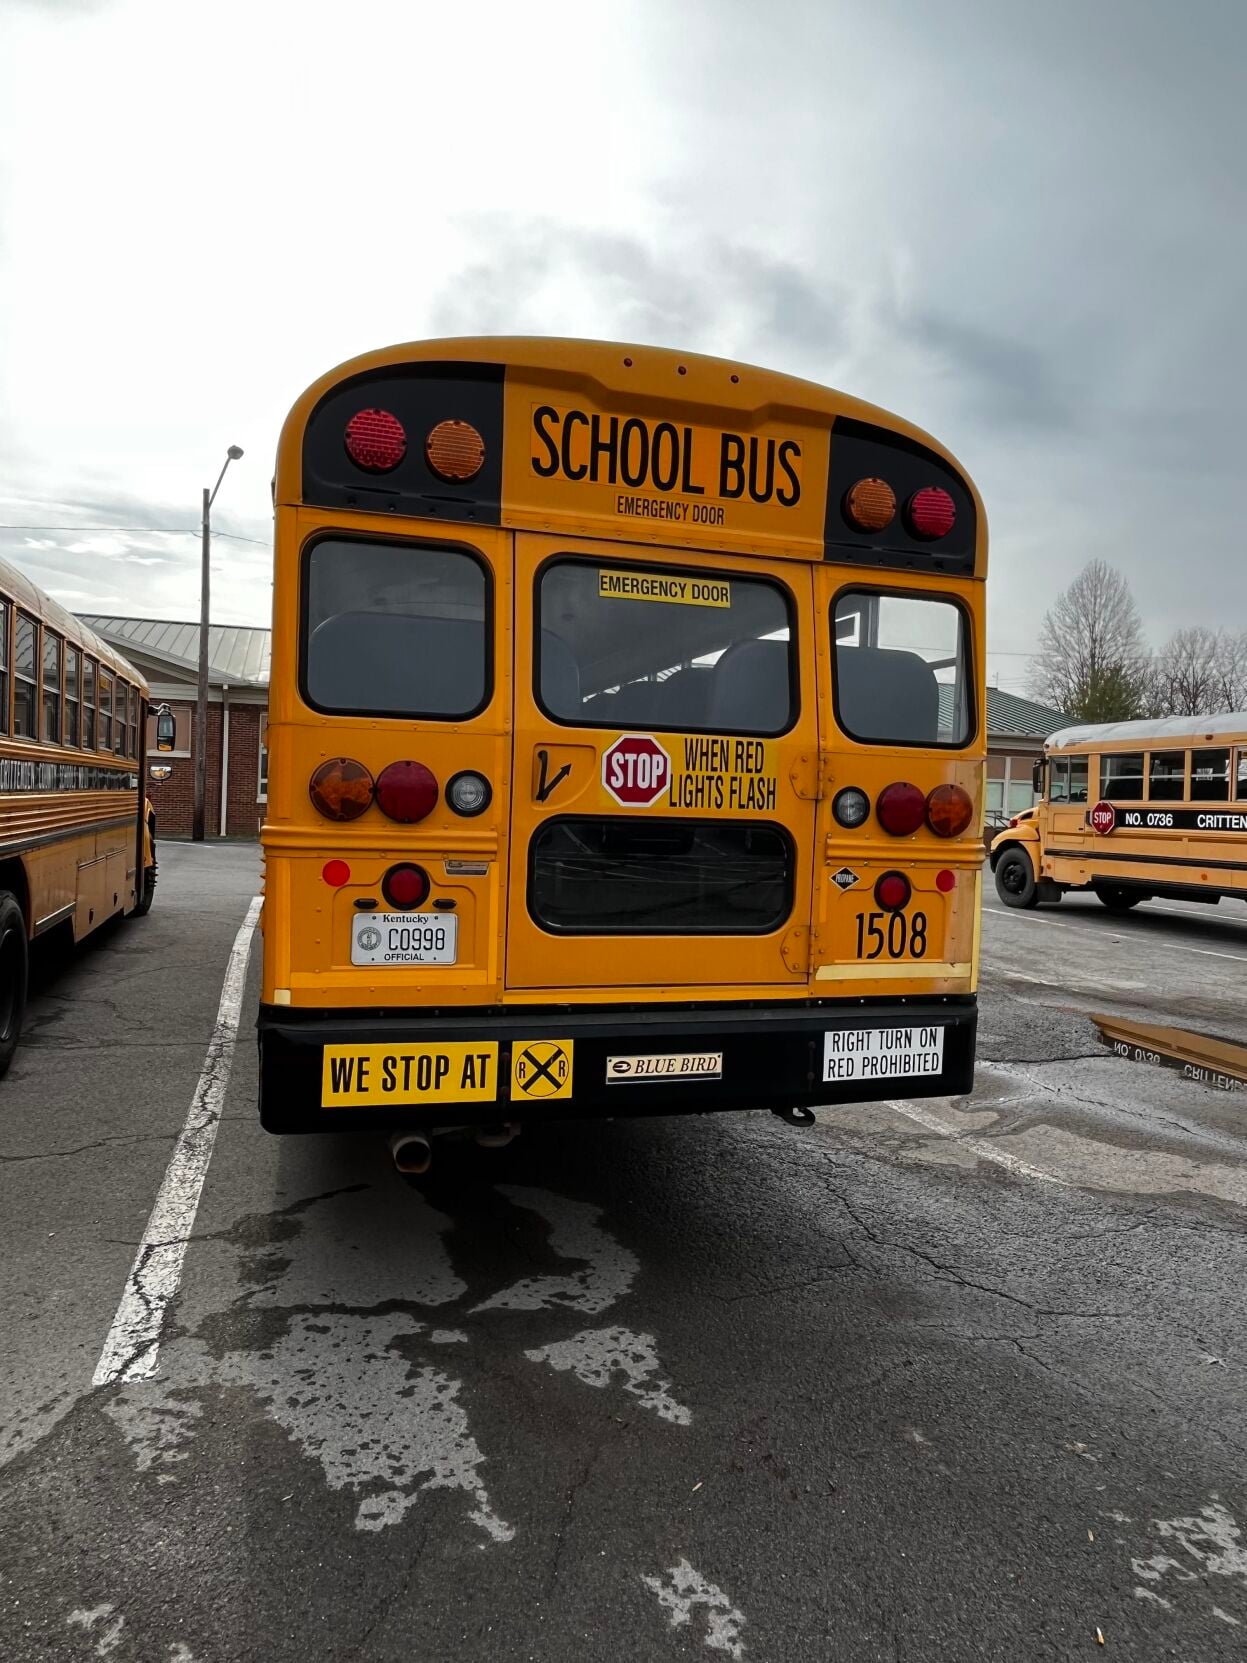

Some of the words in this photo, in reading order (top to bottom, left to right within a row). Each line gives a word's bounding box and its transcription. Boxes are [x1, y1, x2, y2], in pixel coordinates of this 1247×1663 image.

[531, 405, 705, 494] SCHOOL
[718, 432, 802, 507] BUS
[617, 496, 690, 522] EMERGENCY
[692, 504, 725, 526] DOOR
[600, 575, 687, 598] EMERGENCY
[691, 583, 729, 602] DOOR
[684, 737, 730, 773] WHEN
[734, 740, 765, 774] RED
[610, 752, 665, 789] STOP
[669, 773, 724, 809] LIGHTS
[729, 775, 777, 810] FLASH
[1093, 811, 1112, 824] STOP
[1125, 812, 1143, 826] NO.
[1146, 813, 1173, 826] 0736
[382, 914, 429, 924] Kentucky
[388, 928, 445, 951] C0998
[855, 911, 927, 960] 1508
[384, 953, 424, 961] OFFICIAL
[832, 1031, 872, 1053] RIGHT
[878, 1029, 912, 1050] TURN
[919, 1028, 937, 1048] ON
[330, 1056, 370, 1094] WE
[381, 1055, 450, 1092] STOP
[460, 1054, 491, 1089] AT
[634, 1058, 677, 1074] BLUE
[680, 1056, 718, 1073] BIRD
[828, 1057, 854, 1079] RED
[862, 1052, 939, 1076] PROHIBITED
